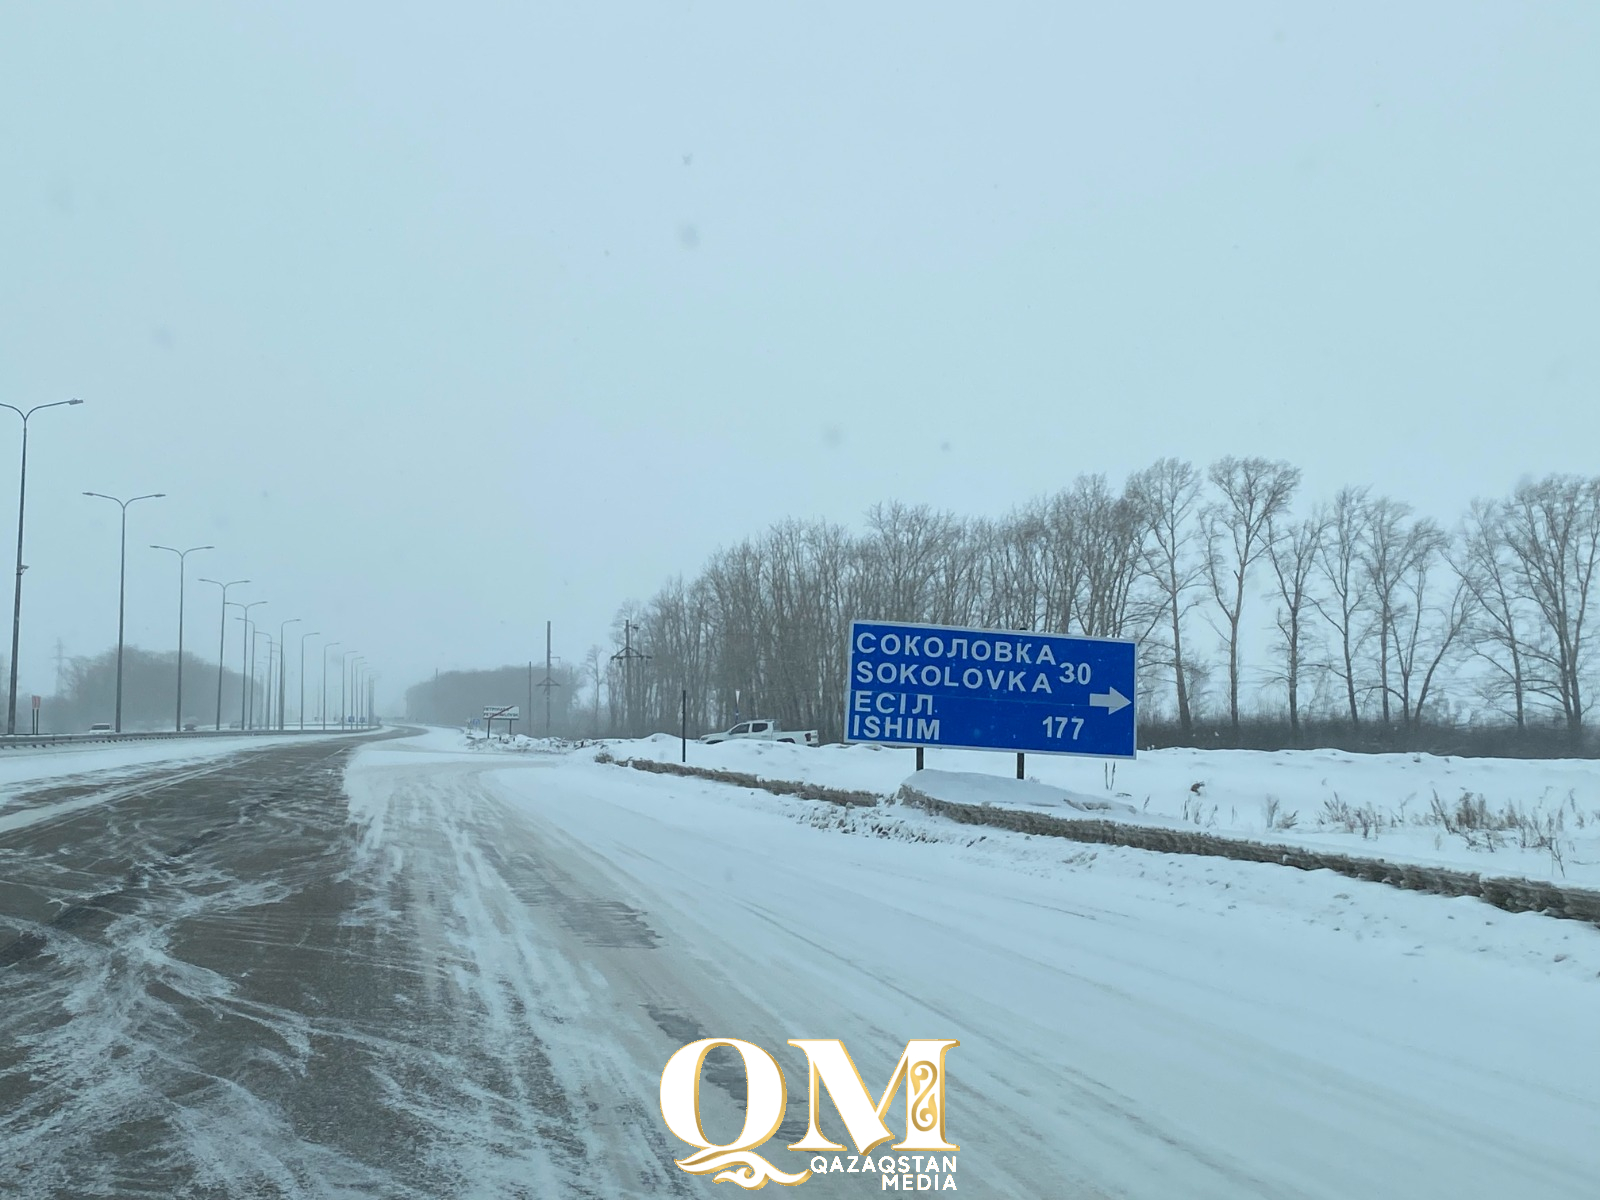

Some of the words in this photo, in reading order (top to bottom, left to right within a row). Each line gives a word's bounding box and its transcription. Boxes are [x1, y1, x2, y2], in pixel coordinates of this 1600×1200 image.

[856, 632, 1056, 665] СОКОЛОВКА
[856, 661, 1052, 693] SOKOLOVKA
[1059, 662, 1092, 685] 30
[855, 690, 933, 715] ЕСІЛ
[853, 714, 940, 740] ISHIM
[1042, 715, 1085, 740] 177
